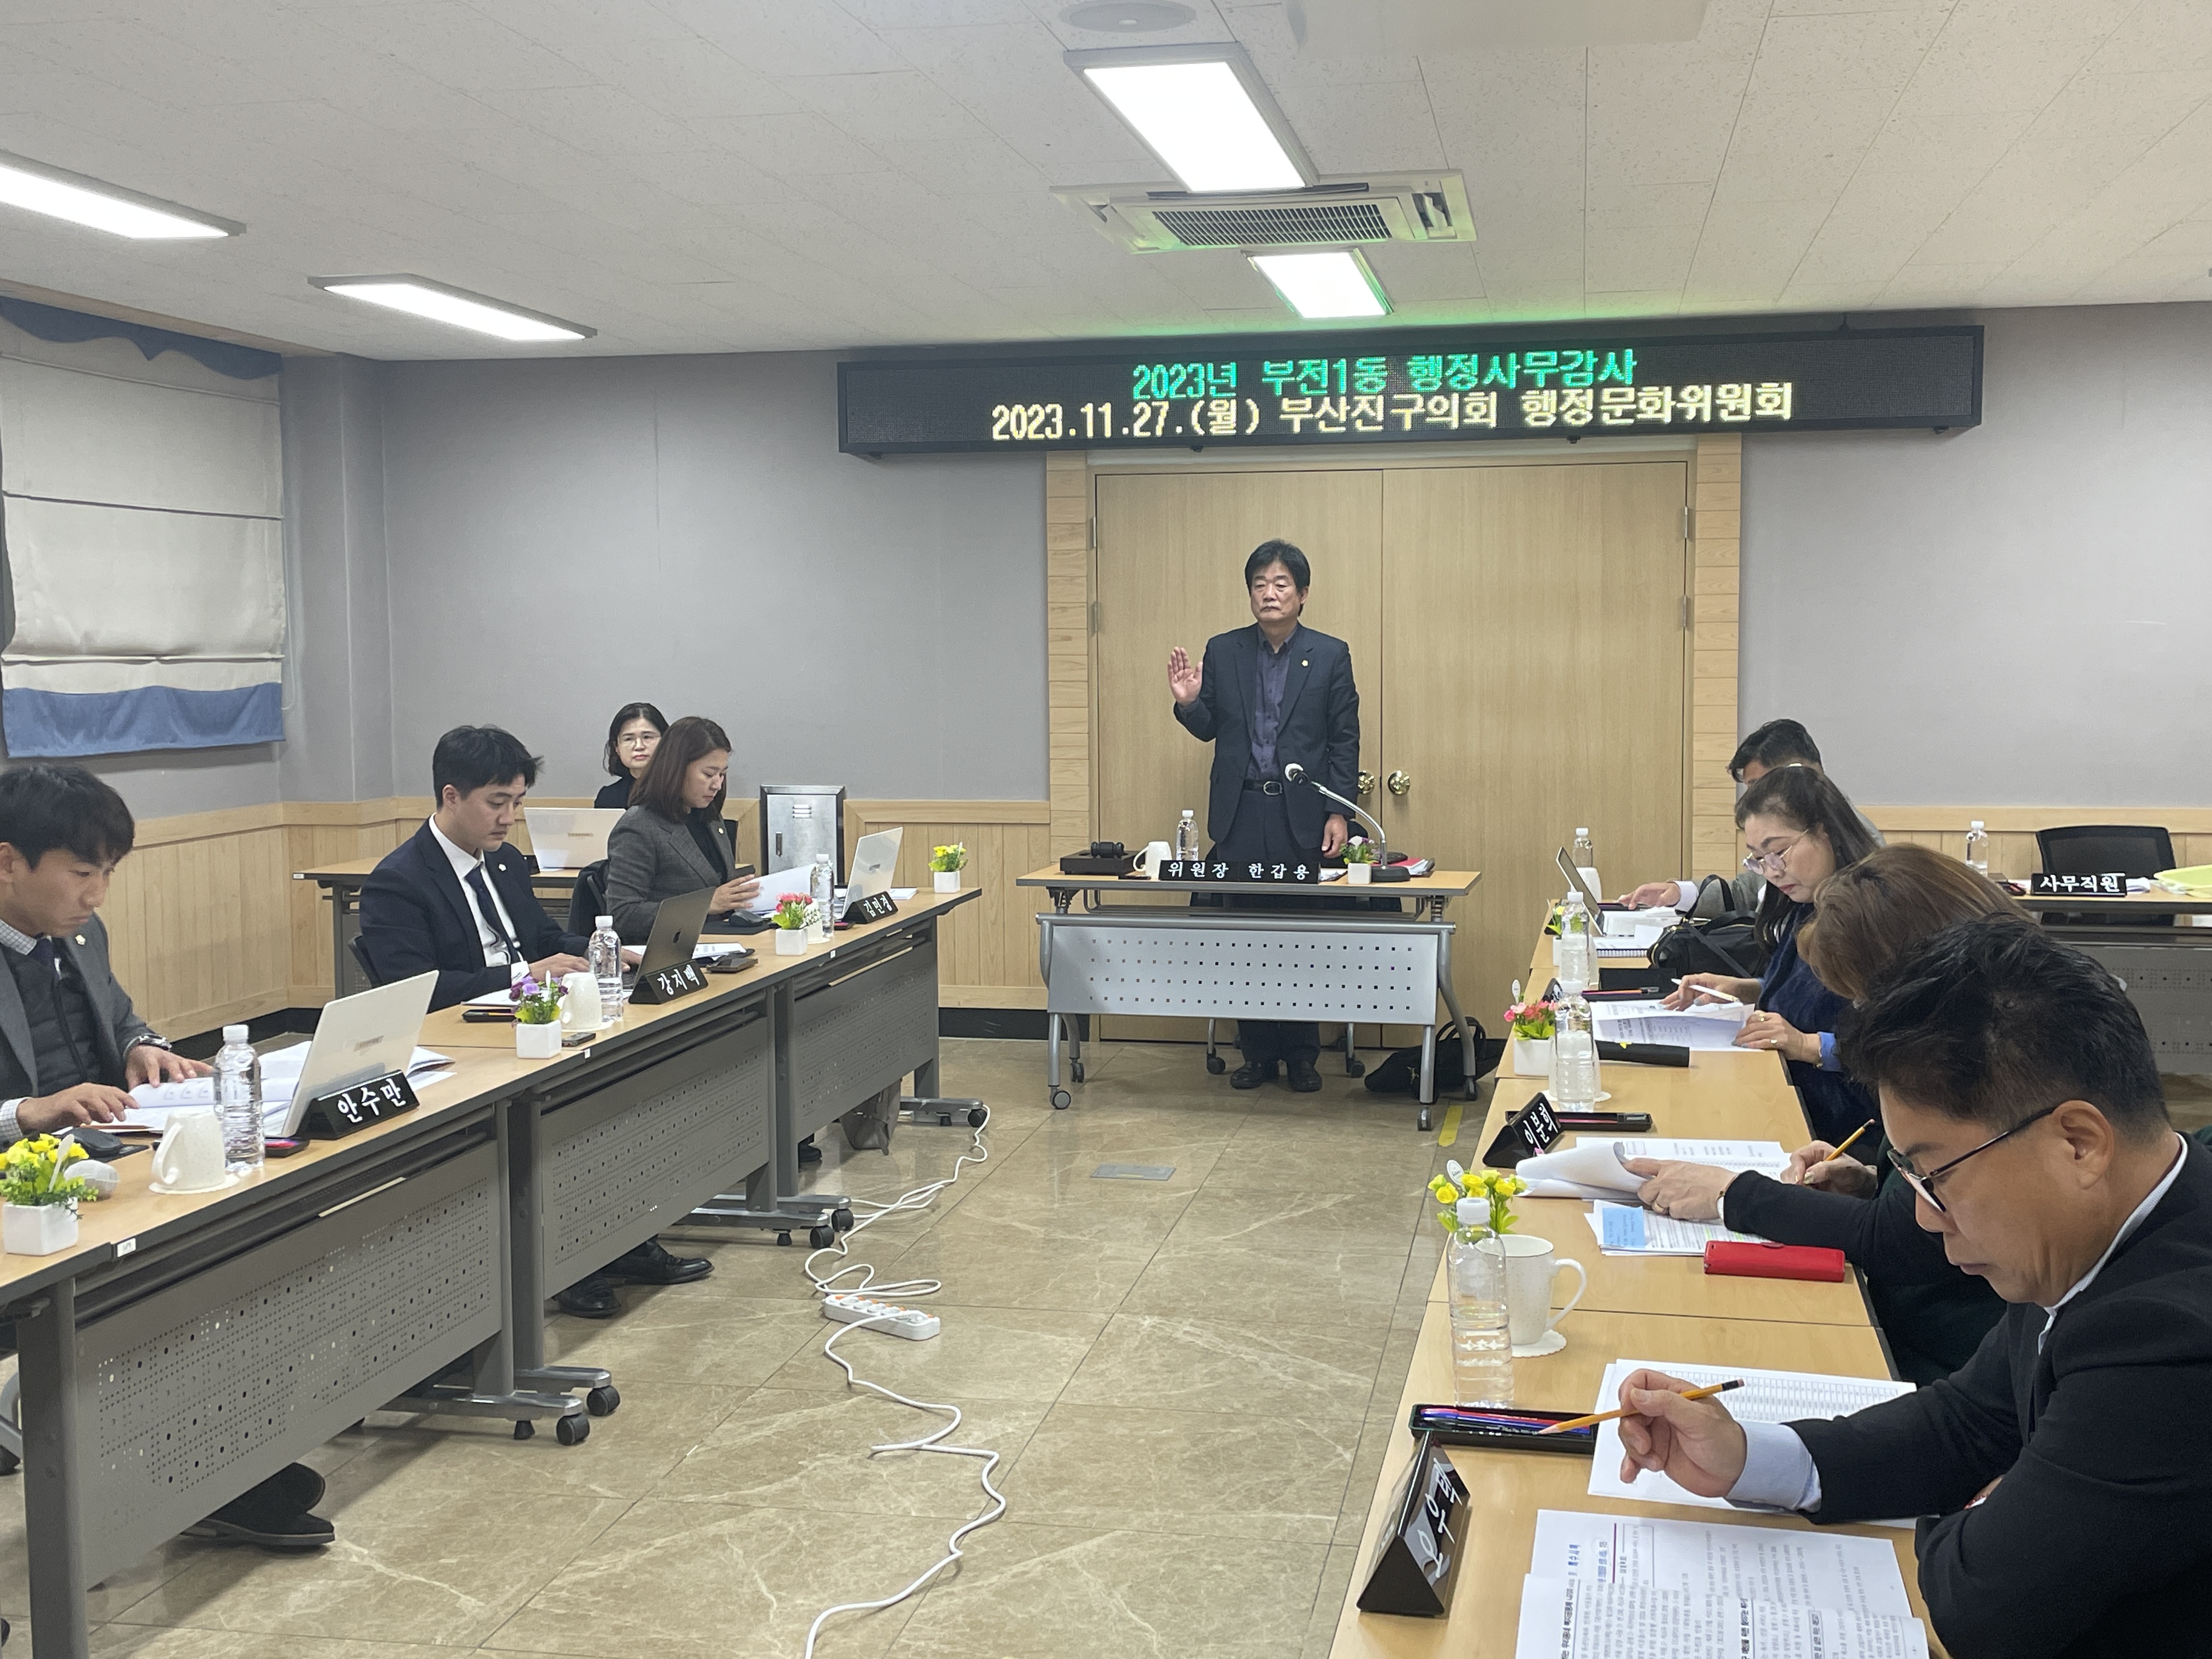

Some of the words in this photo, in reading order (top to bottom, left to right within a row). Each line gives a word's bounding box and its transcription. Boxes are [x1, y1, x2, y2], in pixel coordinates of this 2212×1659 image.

[1132, 362, 1237, 400] 2023년
[1262, 357, 1389, 397] 부전1동
[1407, 349, 1638, 392] 행정사무감사
[991, 398, 1260, 440] 2023.11.27.(월)
[1279, 391, 1498, 434] 부산진구의회
[1520, 382, 1792, 427] 행정문화위원회
[1167, 861, 1229, 879] 위원장
[1248, 862, 1310, 881] 한갑용
[2040, 874, 2120, 893] 사무직원
[337, 1078, 407, 1123] 안수만
[1523, 1103, 1559, 1150] 이분희
[1417, 1457, 1463, 1578] 오우택
